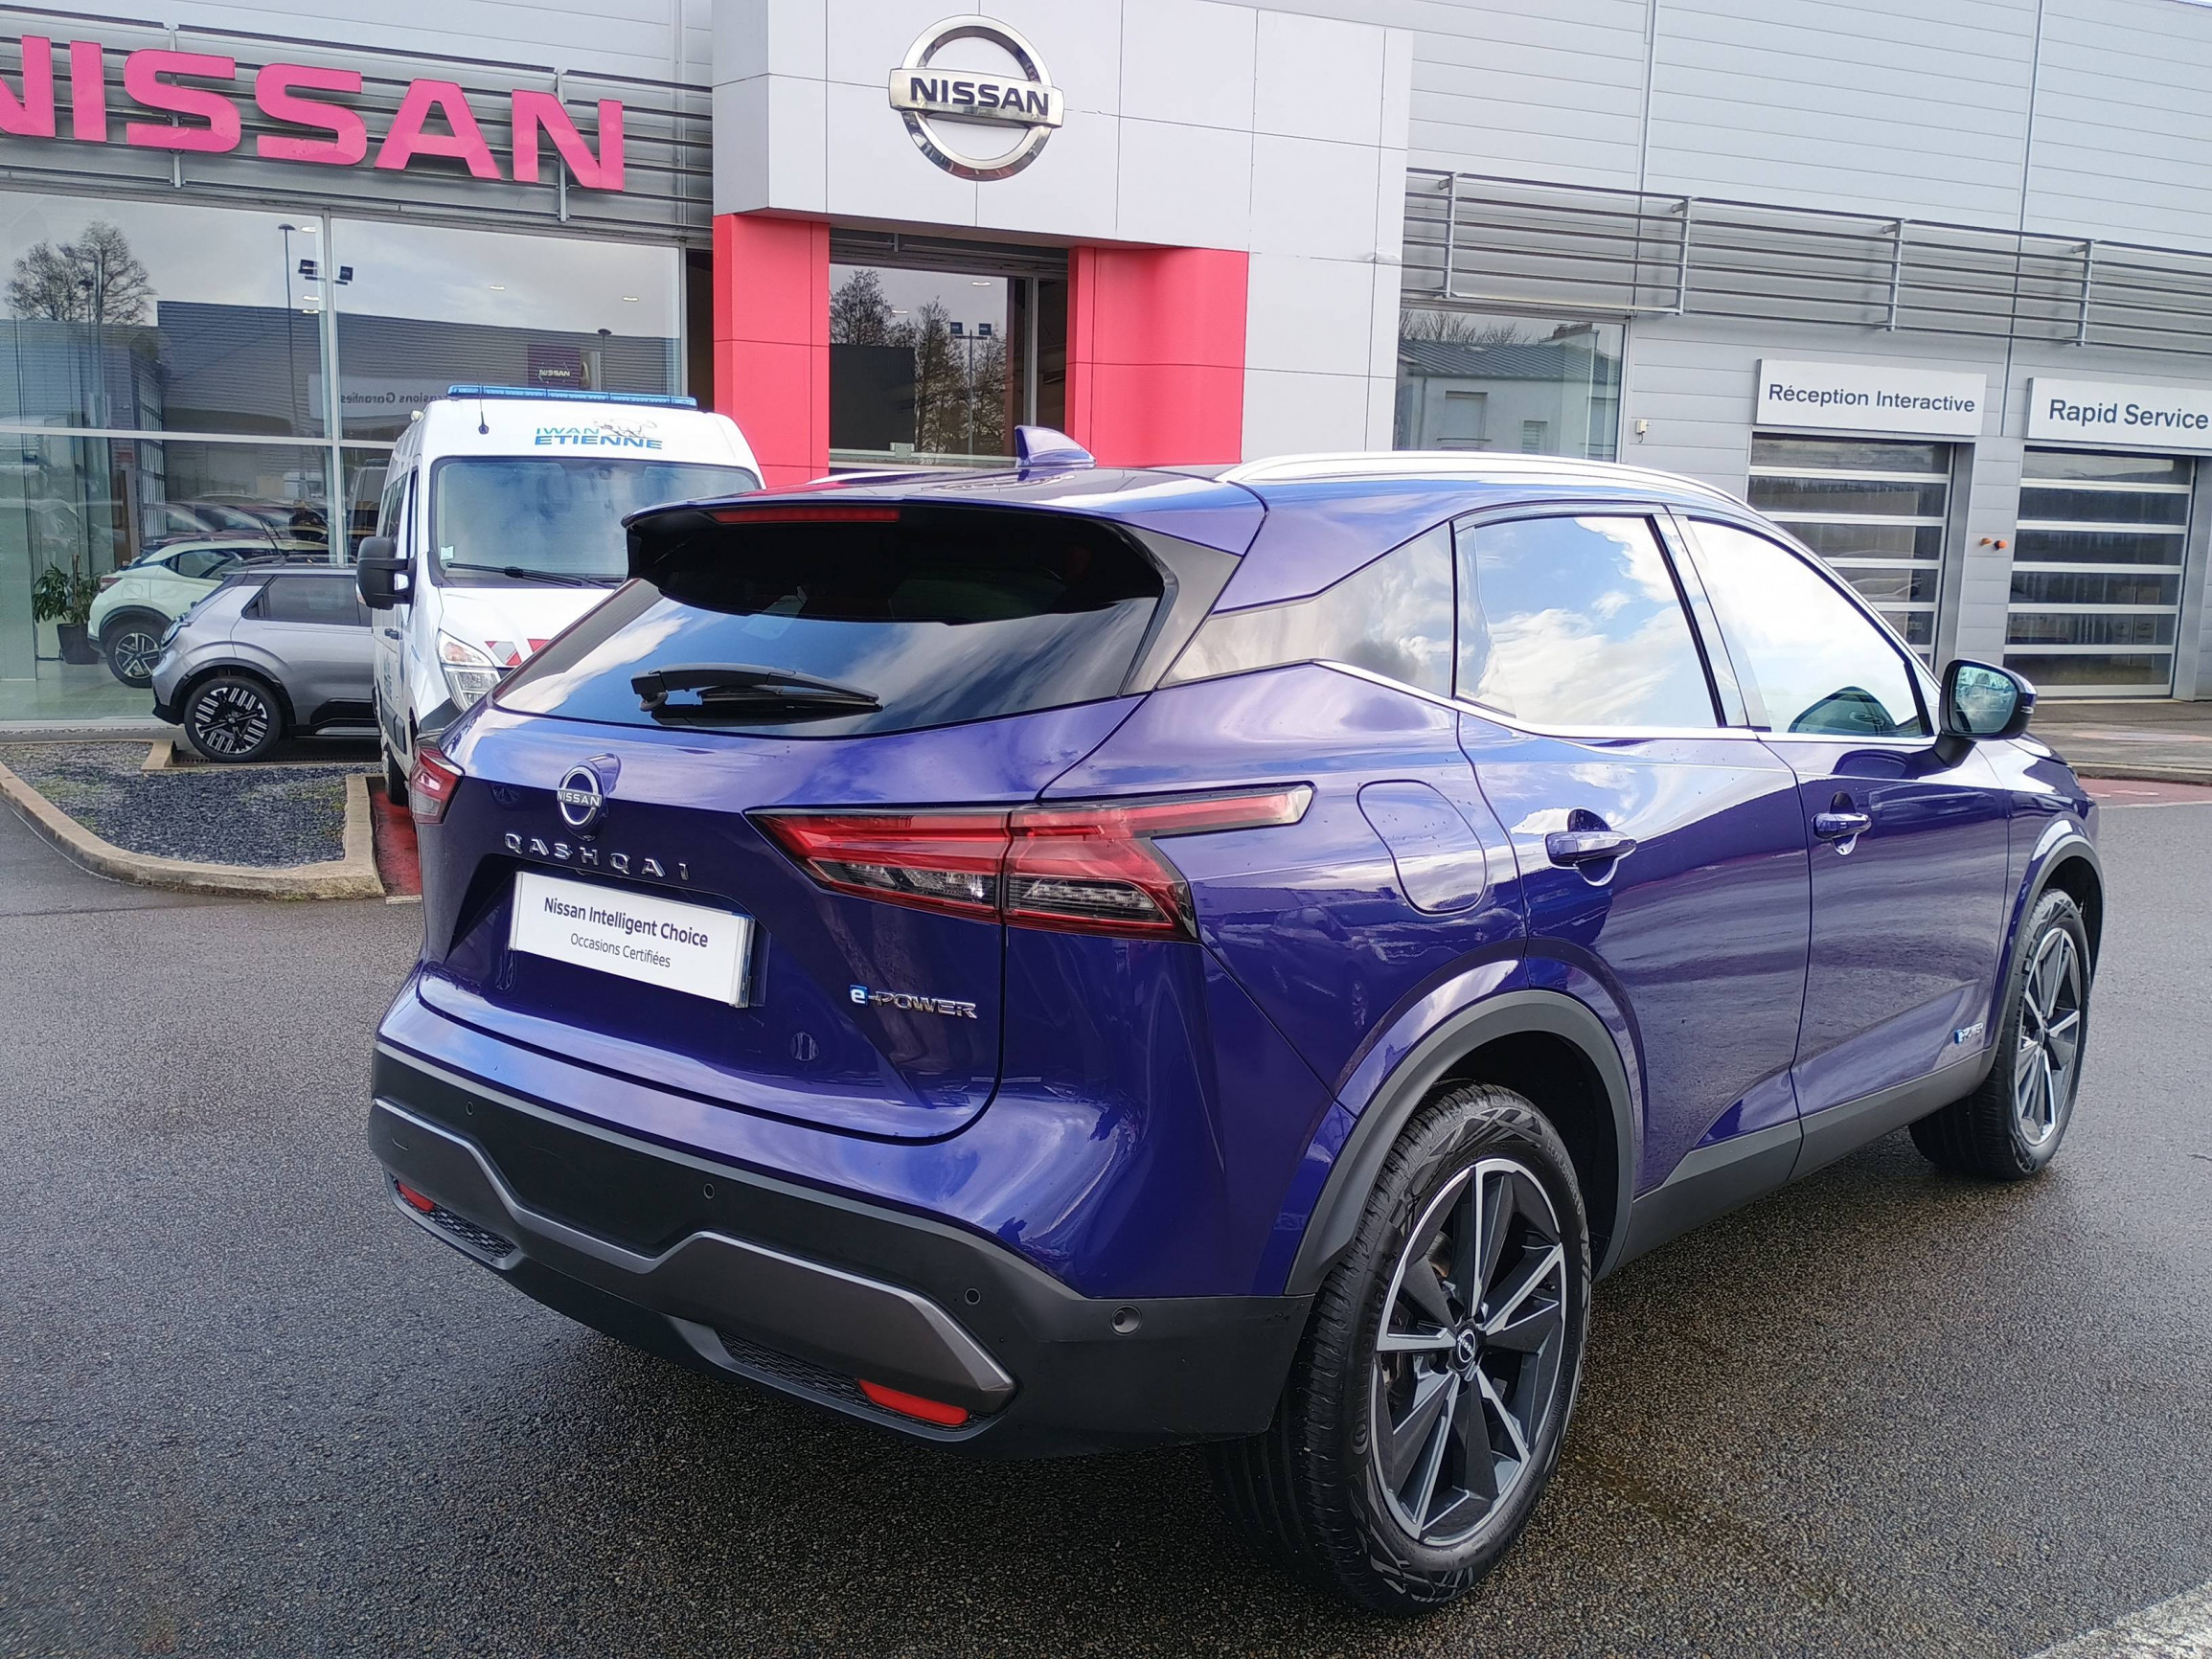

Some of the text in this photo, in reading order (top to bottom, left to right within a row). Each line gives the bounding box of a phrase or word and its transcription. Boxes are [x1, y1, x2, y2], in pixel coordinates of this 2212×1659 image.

[910, 77, 1049, 116] NISSAN
[1768, 383, 1975, 412] Réception Interactive
[2049, 398, 2209, 430] Rapid Service
[535, 435, 663, 450] ETIENNE
[557, 788, 602, 807] NISSAN
[505, 832, 691, 881] QASHQAI
[543, 897, 709, 948] Nissan Intelligent Choice
[570, 933, 672, 968] Occasions Certifiées
[850, 987, 978, 1019] e-POWER
